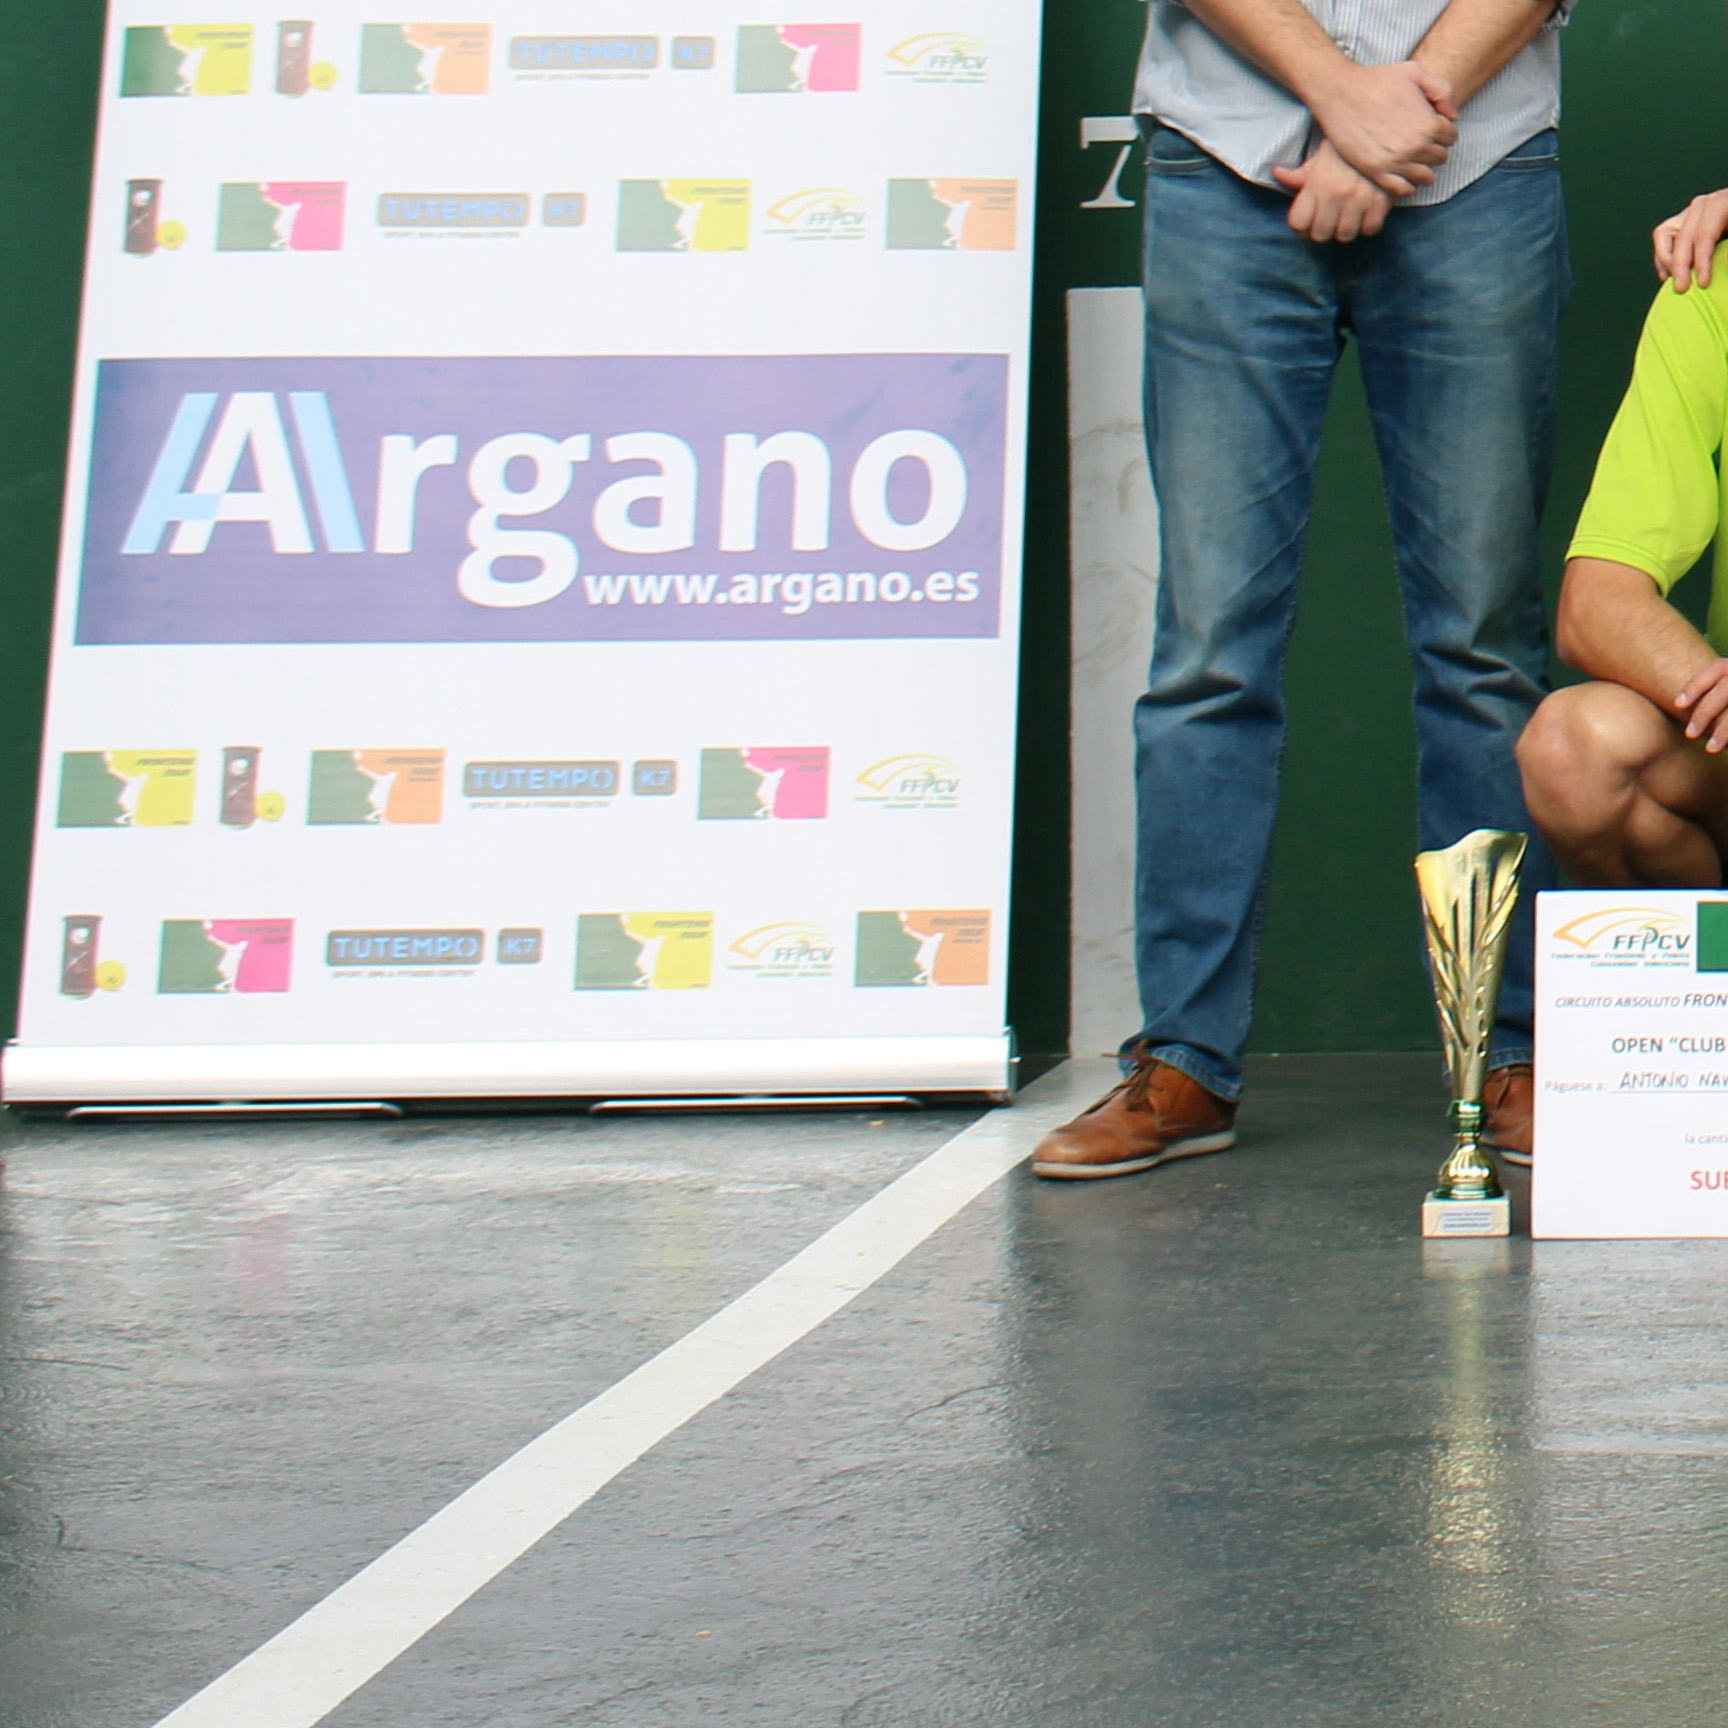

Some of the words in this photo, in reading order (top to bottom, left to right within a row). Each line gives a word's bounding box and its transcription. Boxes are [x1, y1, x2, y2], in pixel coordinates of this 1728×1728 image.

[1080, 115, 1141, 209] 7
[121, 391, 966, 608] Argano
[583, 566, 980, 615] www.argano.es
[336, 937, 481, 959] TUTEMPO
[1612, 925, 1691, 952] FFPCV
[1555, 996, 1612, 1008] CIRCUITO
[1614, 996, 1680, 1007] ABSOLUTO
[1612, 1037, 1662, 1054] OPEN
[1544, 1079, 1591, 1094] Páguese
[1619, 1071, 1688, 1090] ANTONIO
[1685, 1133, 1696, 1144] la
